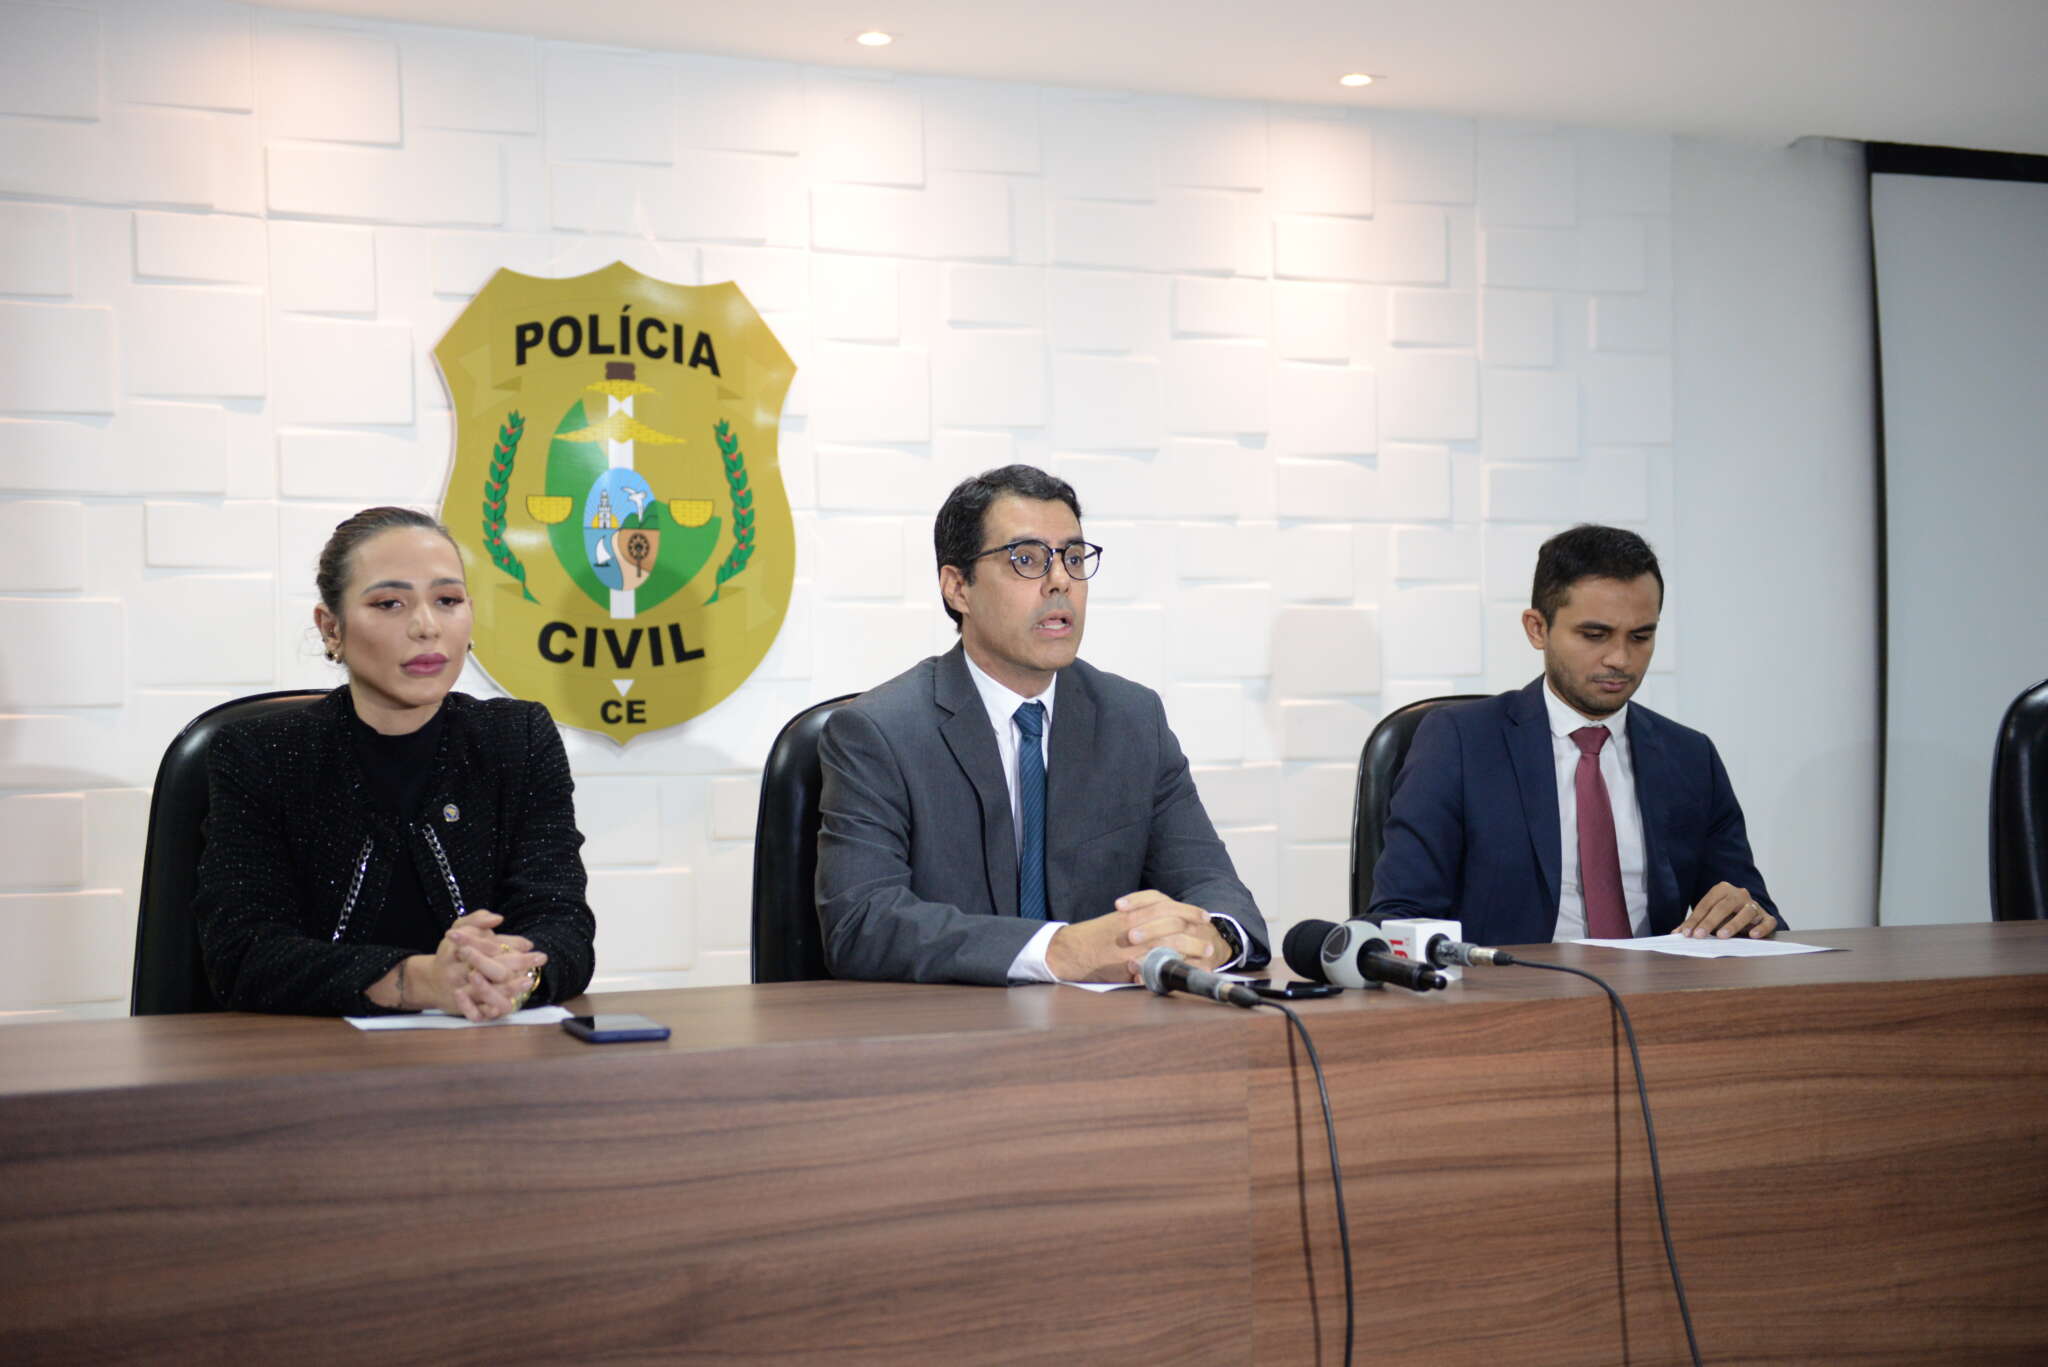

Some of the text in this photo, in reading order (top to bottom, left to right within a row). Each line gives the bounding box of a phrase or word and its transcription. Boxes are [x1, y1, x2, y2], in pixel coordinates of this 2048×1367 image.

[515, 304, 721, 378] POLÍCIA
[537, 621, 706, 670] CIVIL
[600, 699, 648, 725] CE
